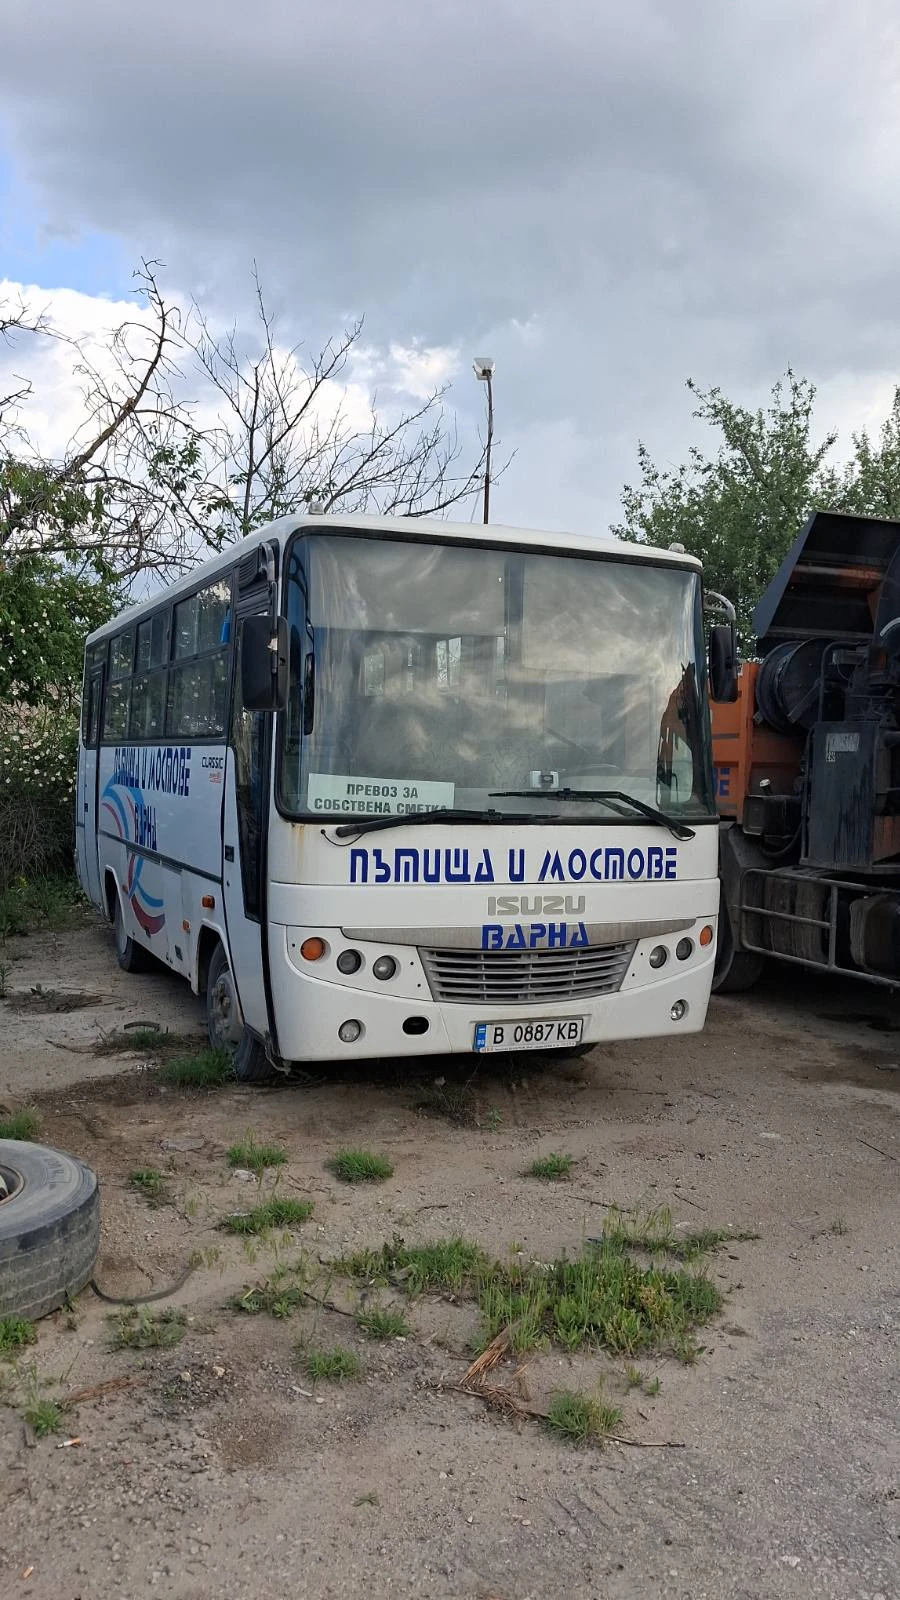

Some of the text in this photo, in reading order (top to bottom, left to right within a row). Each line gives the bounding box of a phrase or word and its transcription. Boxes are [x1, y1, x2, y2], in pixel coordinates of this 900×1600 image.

[202, 757, 223, 769] CLASSIC
[346, 783, 418, 798] ПРЕВОЗ ЗА
[314, 798, 391, 814] СОБСТВЕНА
[350, 847, 677, 882] ПЪТИЩА И МОСТОВЕ
[487, 895, 586, 916] ISUZU
[481, 922, 590, 949] ВАРНА
